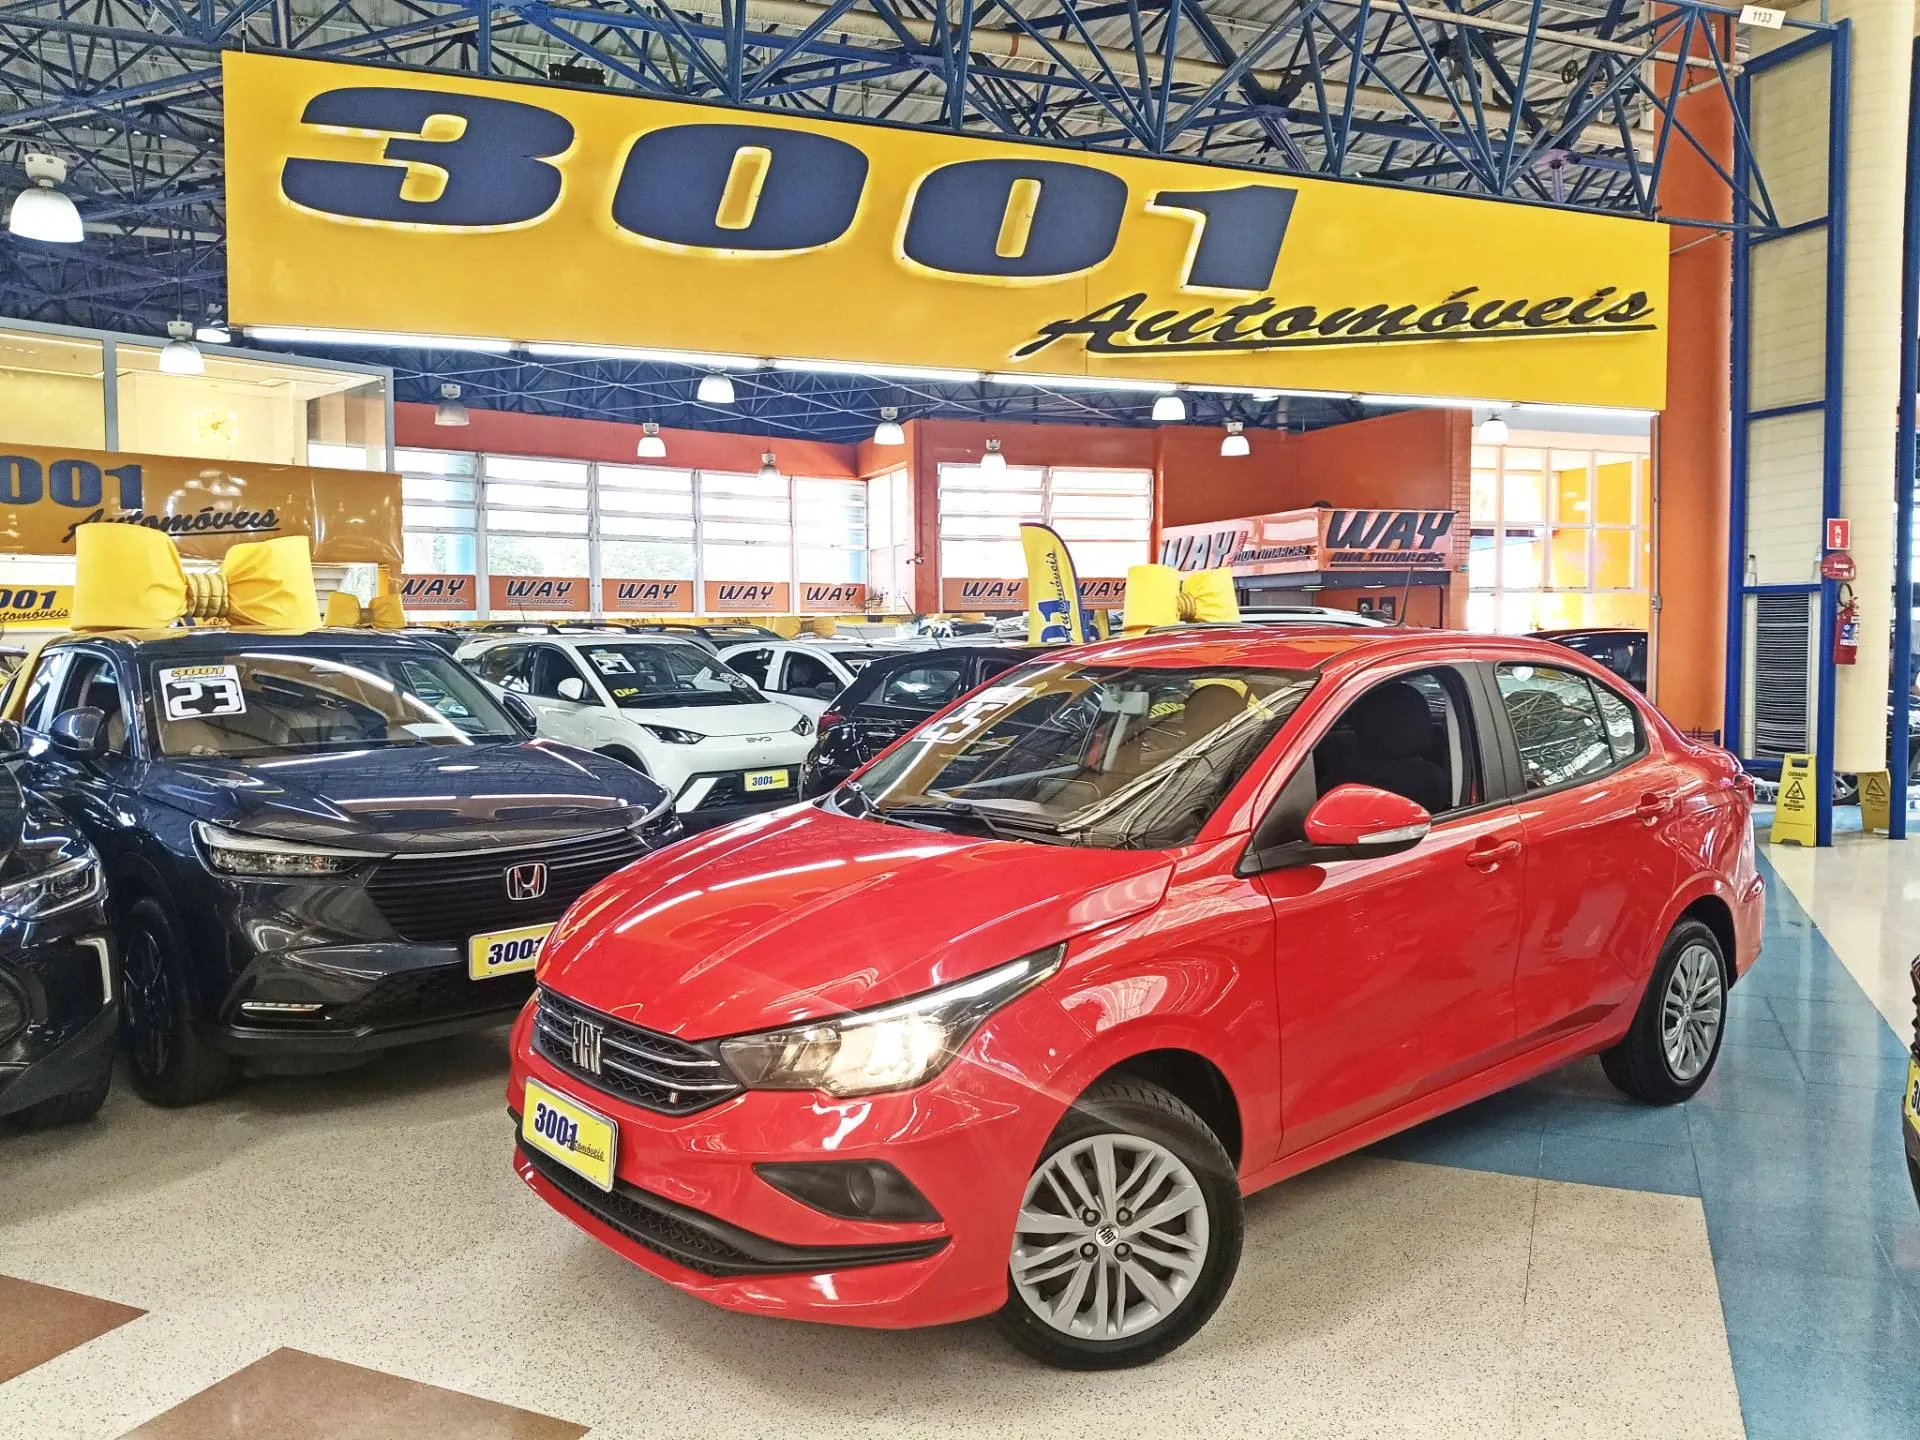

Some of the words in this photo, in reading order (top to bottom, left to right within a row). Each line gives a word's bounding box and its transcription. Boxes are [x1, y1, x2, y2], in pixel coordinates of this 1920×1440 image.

[1753, 11, 1772, 23] 1133
[280, 86, 1297, 291] 3001
[1010, 286, 1657, 356] Automóveis
[1326, 510, 1455, 549] WAY
[1158, 531, 1236, 572] WAY
[1331, 552, 1446, 563] MULTIMARCAS
[506, 580, 573, 597] WAY
[617, 583, 678, 599] WAY
[719, 585, 775, 600] WAY
[806, 586, 857, 601] WAY
[962, 581, 1022, 597] WAY
[169, 680, 241, 717] 23
[752, 775, 773, 786] 3001
[572, 1016, 604, 1075] FIAT
[534, 1102, 578, 1150] 3001
[1098, 1226, 1118, 1246] FIAT
